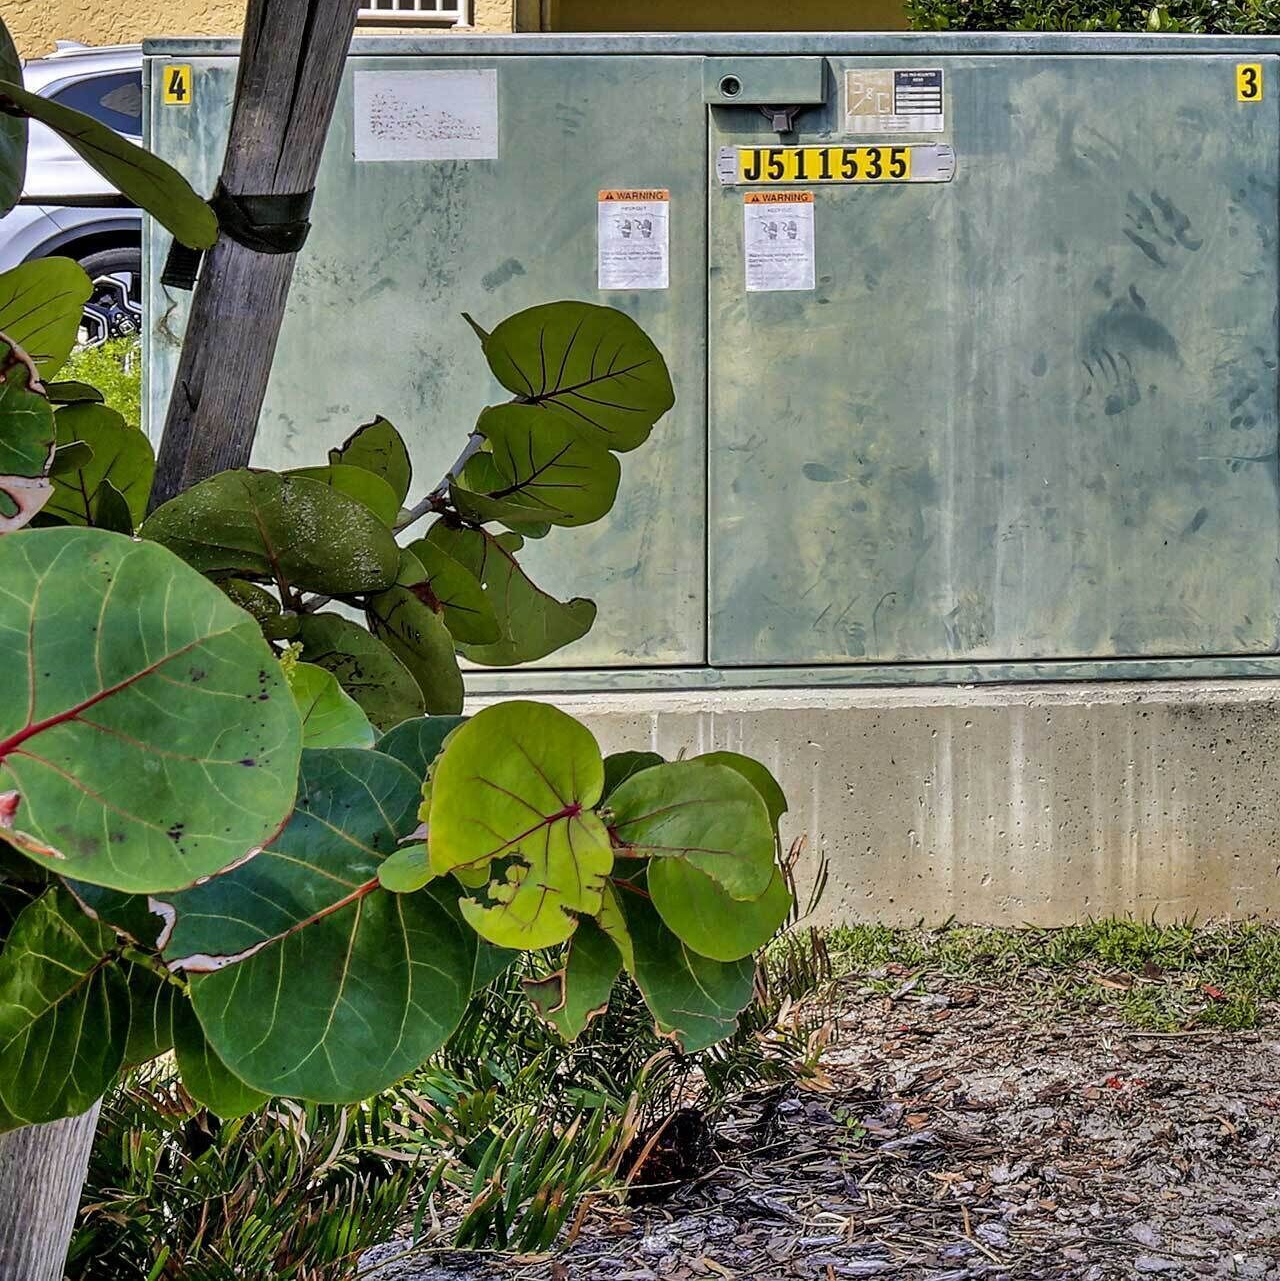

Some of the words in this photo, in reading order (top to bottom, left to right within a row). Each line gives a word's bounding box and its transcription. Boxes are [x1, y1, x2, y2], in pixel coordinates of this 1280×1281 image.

[169, 70, 186, 100] 4
[1241, 68, 1257, 97] 3
[744, 147, 906, 181] J511535
[616, 191, 664, 200] WARNING
[762, 193, 808, 202] WARNING
